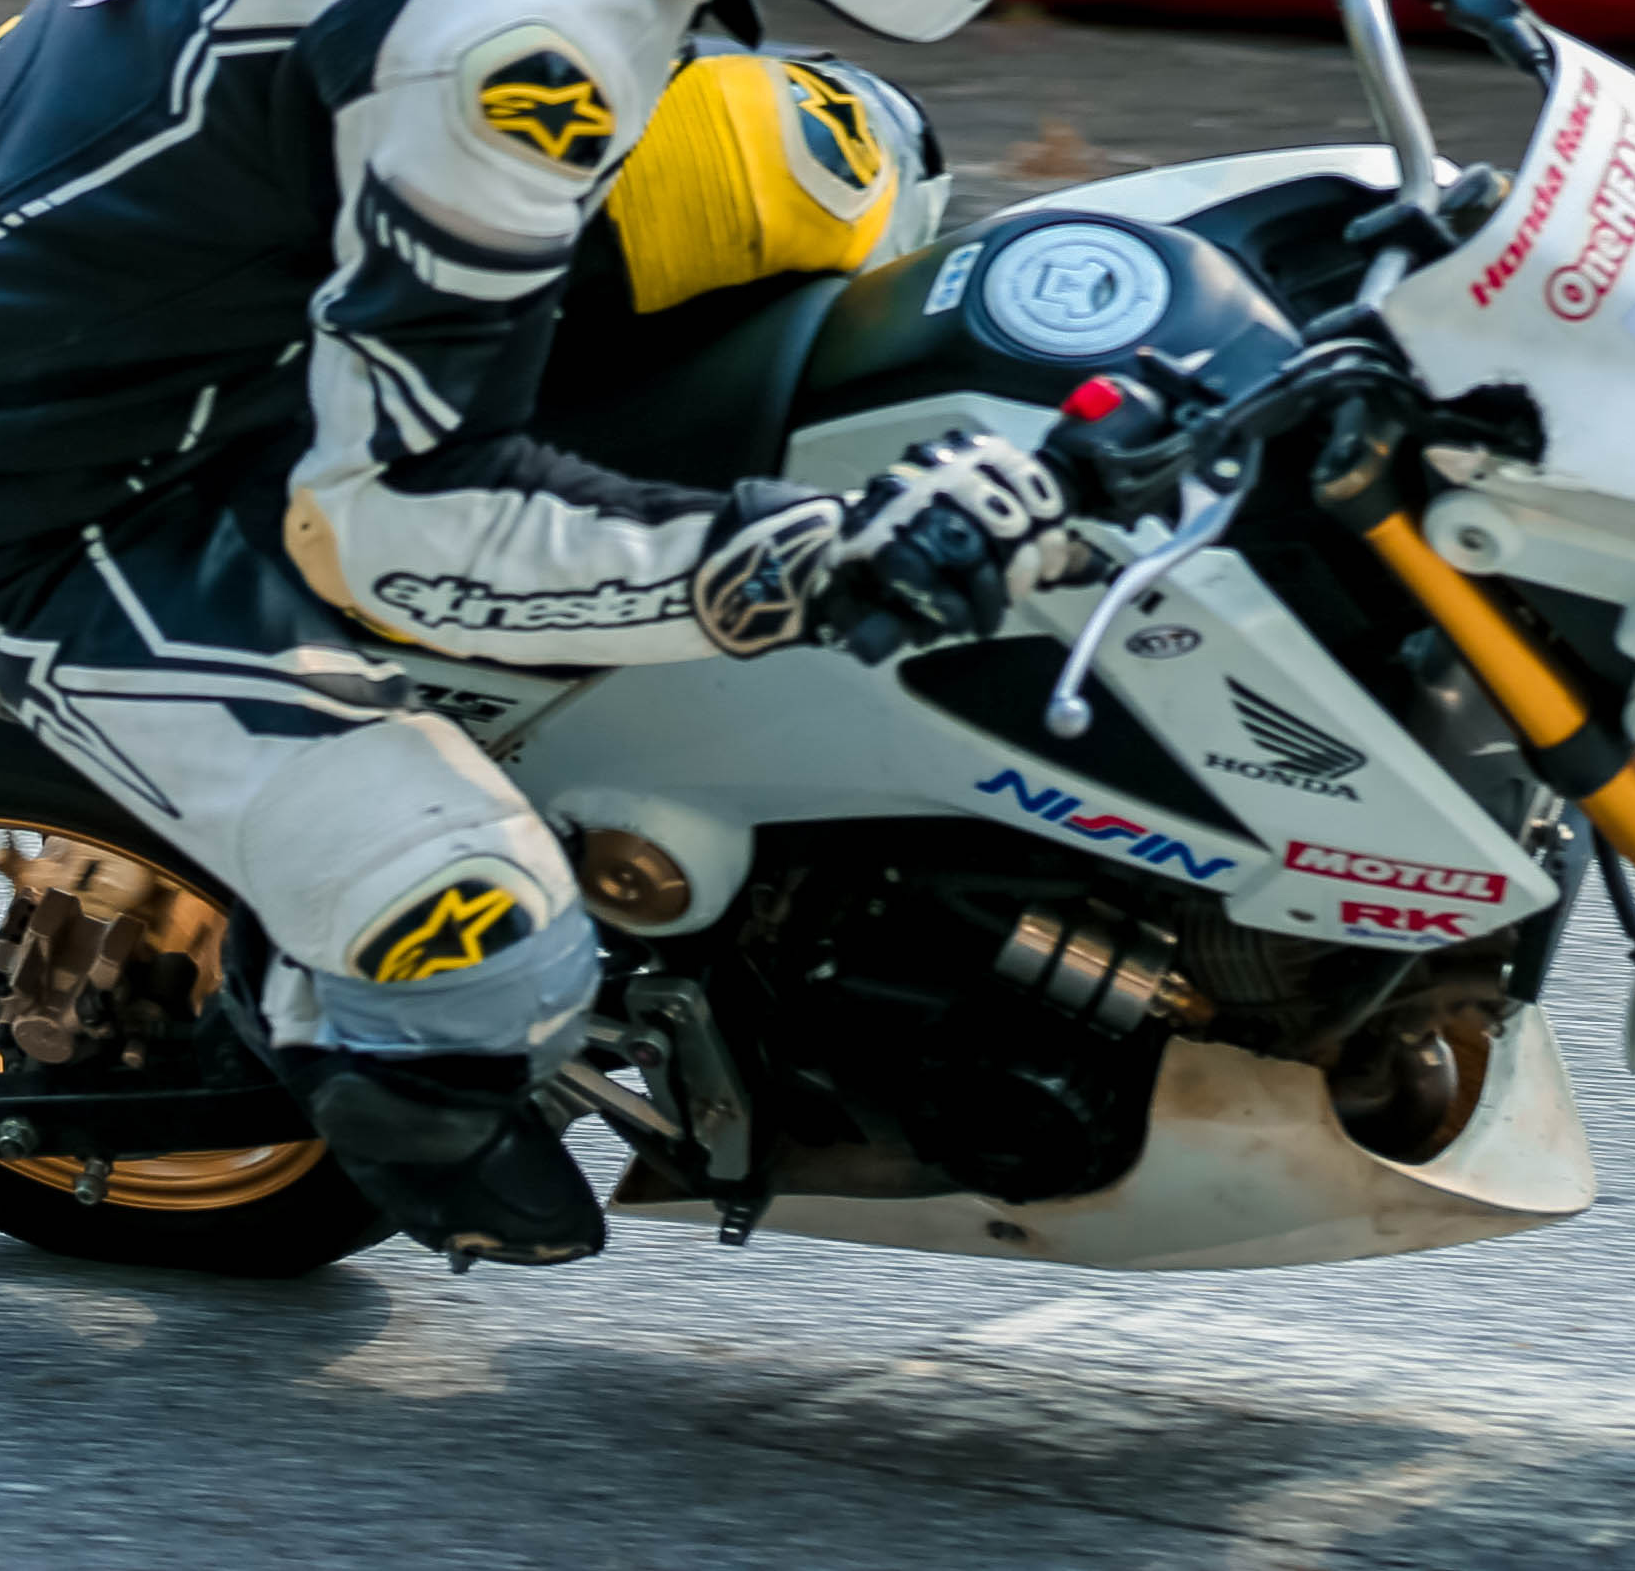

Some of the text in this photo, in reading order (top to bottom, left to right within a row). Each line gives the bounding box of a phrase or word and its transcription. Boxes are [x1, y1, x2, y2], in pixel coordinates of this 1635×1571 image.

[1203, 752, 1364, 803] HONDA
[975, 767, 1238, 881] NISSIN
[1293, 845, 1498, 900] MOTUL
[1340, 900, 1477, 938] RK
